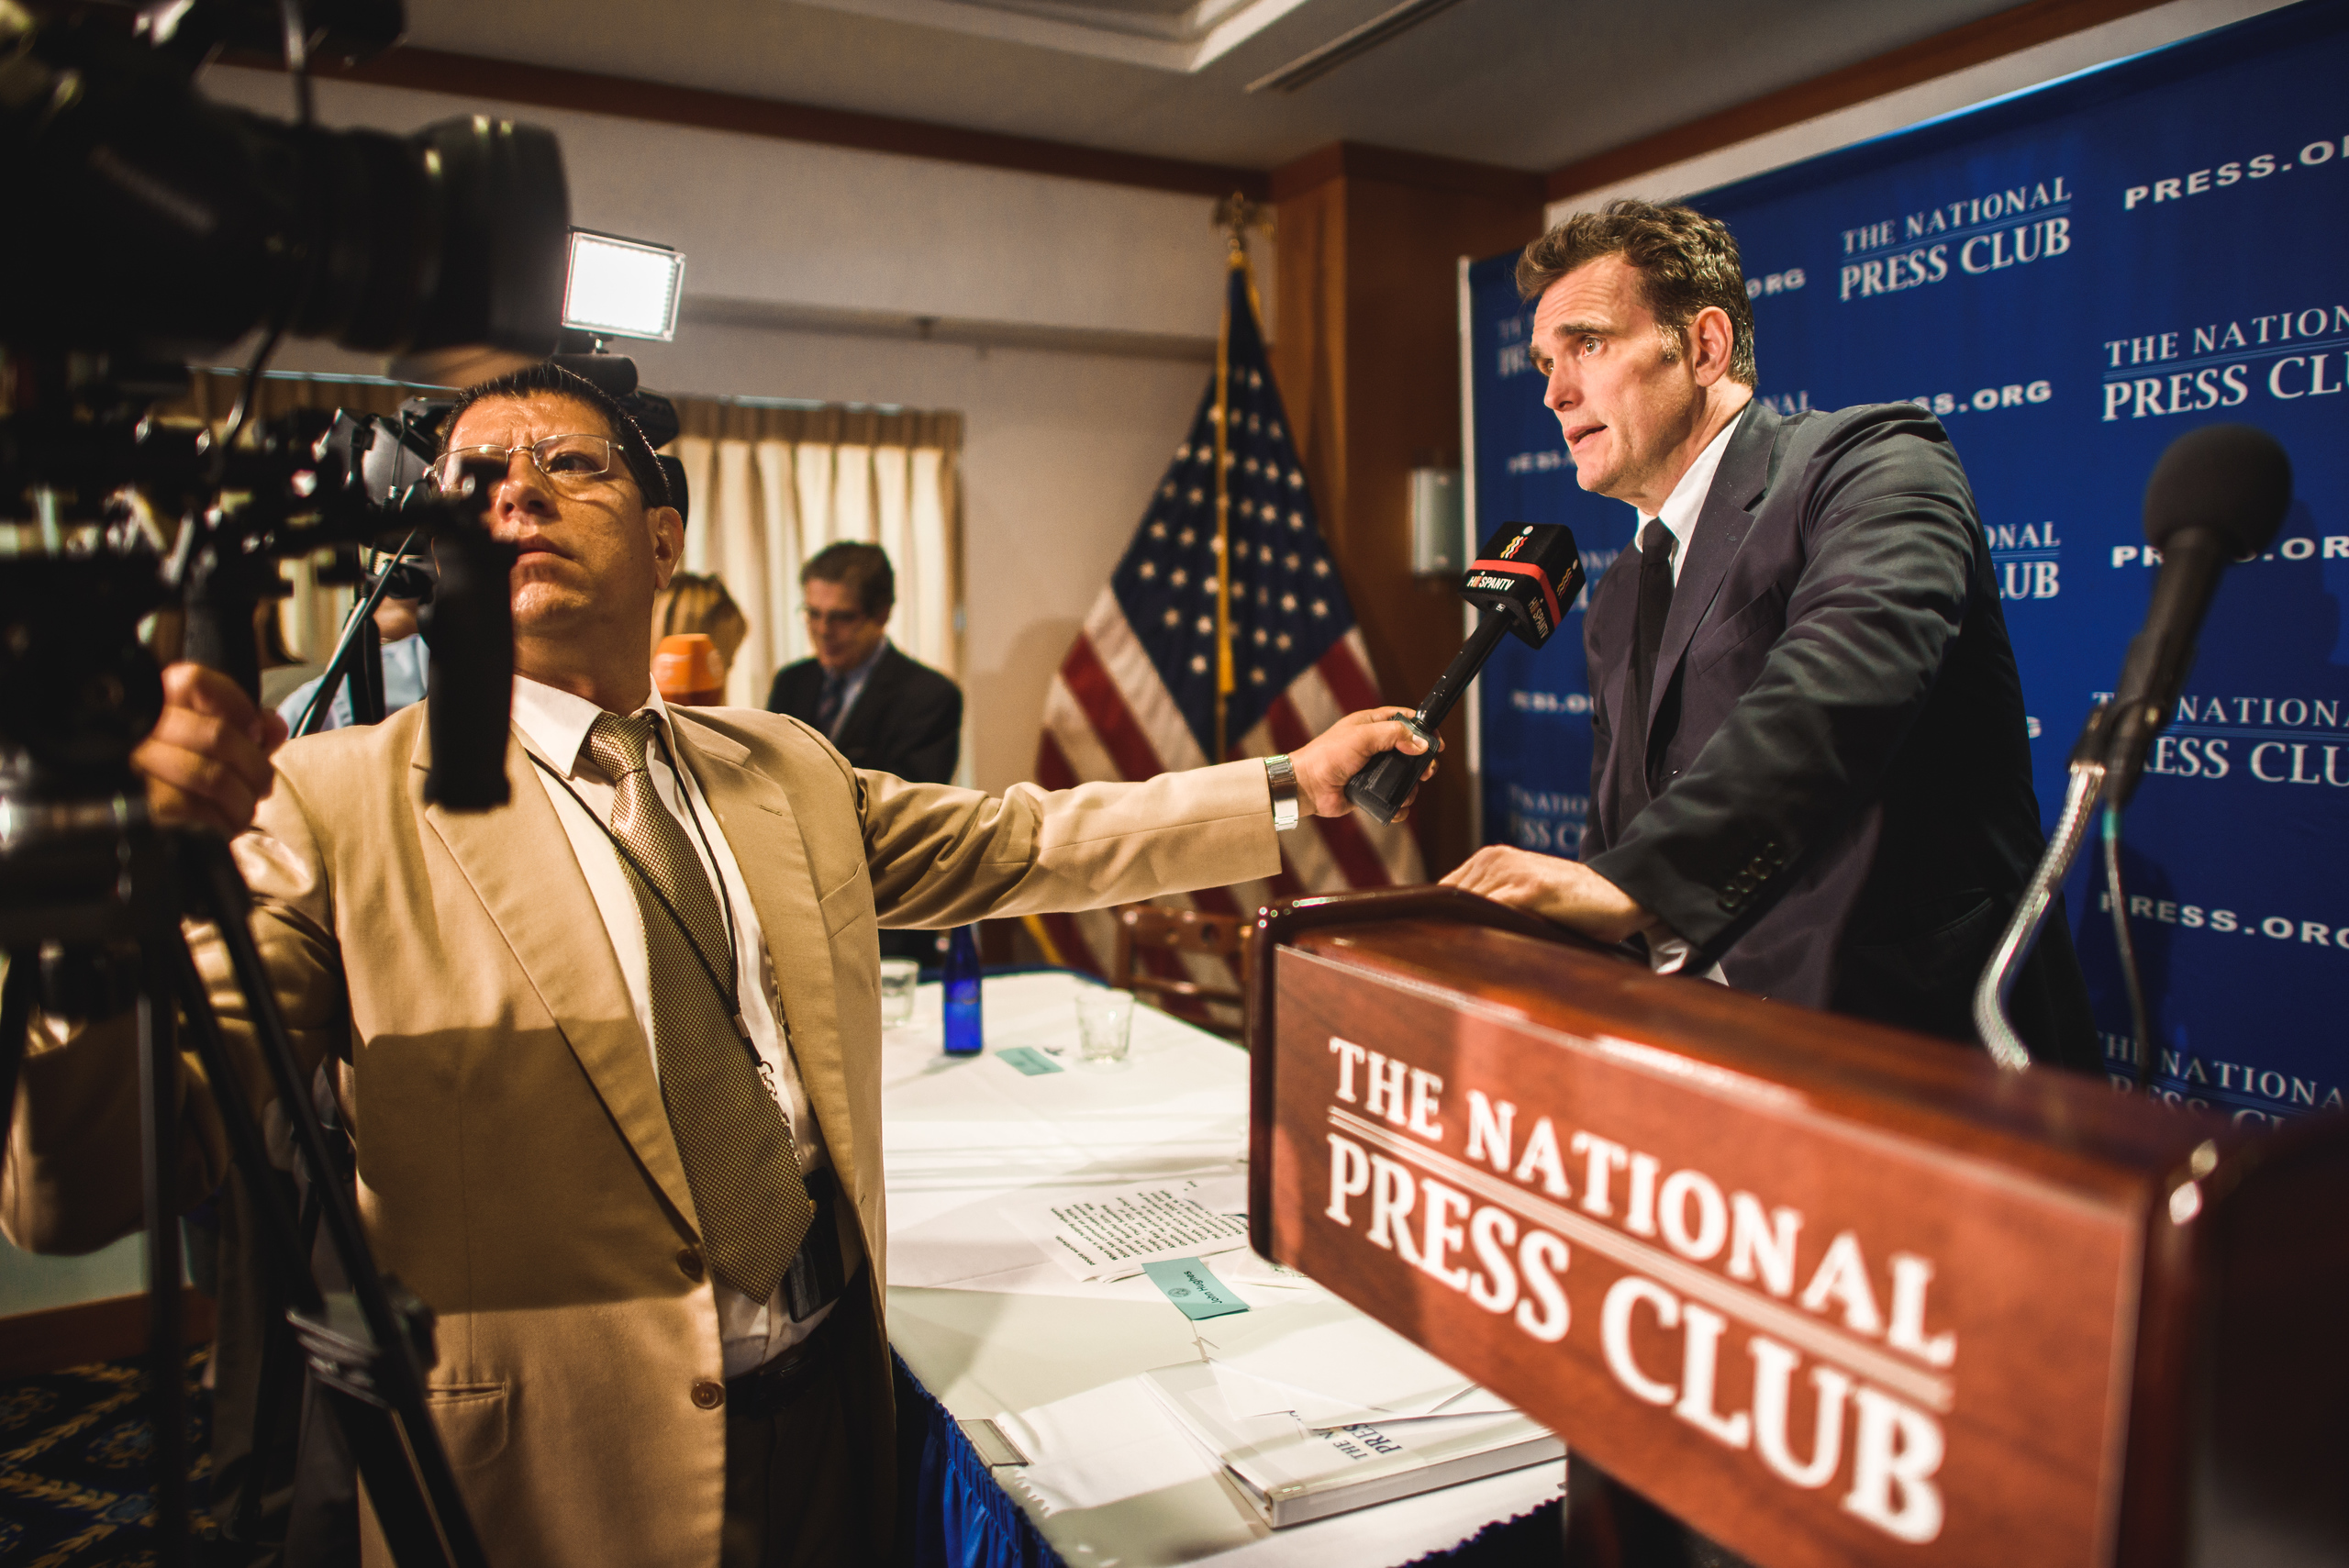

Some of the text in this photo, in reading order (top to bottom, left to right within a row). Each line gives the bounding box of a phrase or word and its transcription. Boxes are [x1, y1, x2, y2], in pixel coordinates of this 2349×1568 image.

[1841, 176, 2072, 254] THE NATIONAL
[1839, 217, 2071, 303] PRESS CLUB
[2104, 332, 2178, 368] THE
[2101, 350, 2349, 423] PRESS CL
[2176, 695, 2349, 728] NATION
[1328, 1035, 1957, 1367] THE NATIONAL
[1183, 1270, 1208, 1293] Hughes
[1204, 1291, 1223, 1304] John
[1324, 1131, 1946, 1544] PRESS CLUB
[1332, 1440, 1368, 1461] THE
